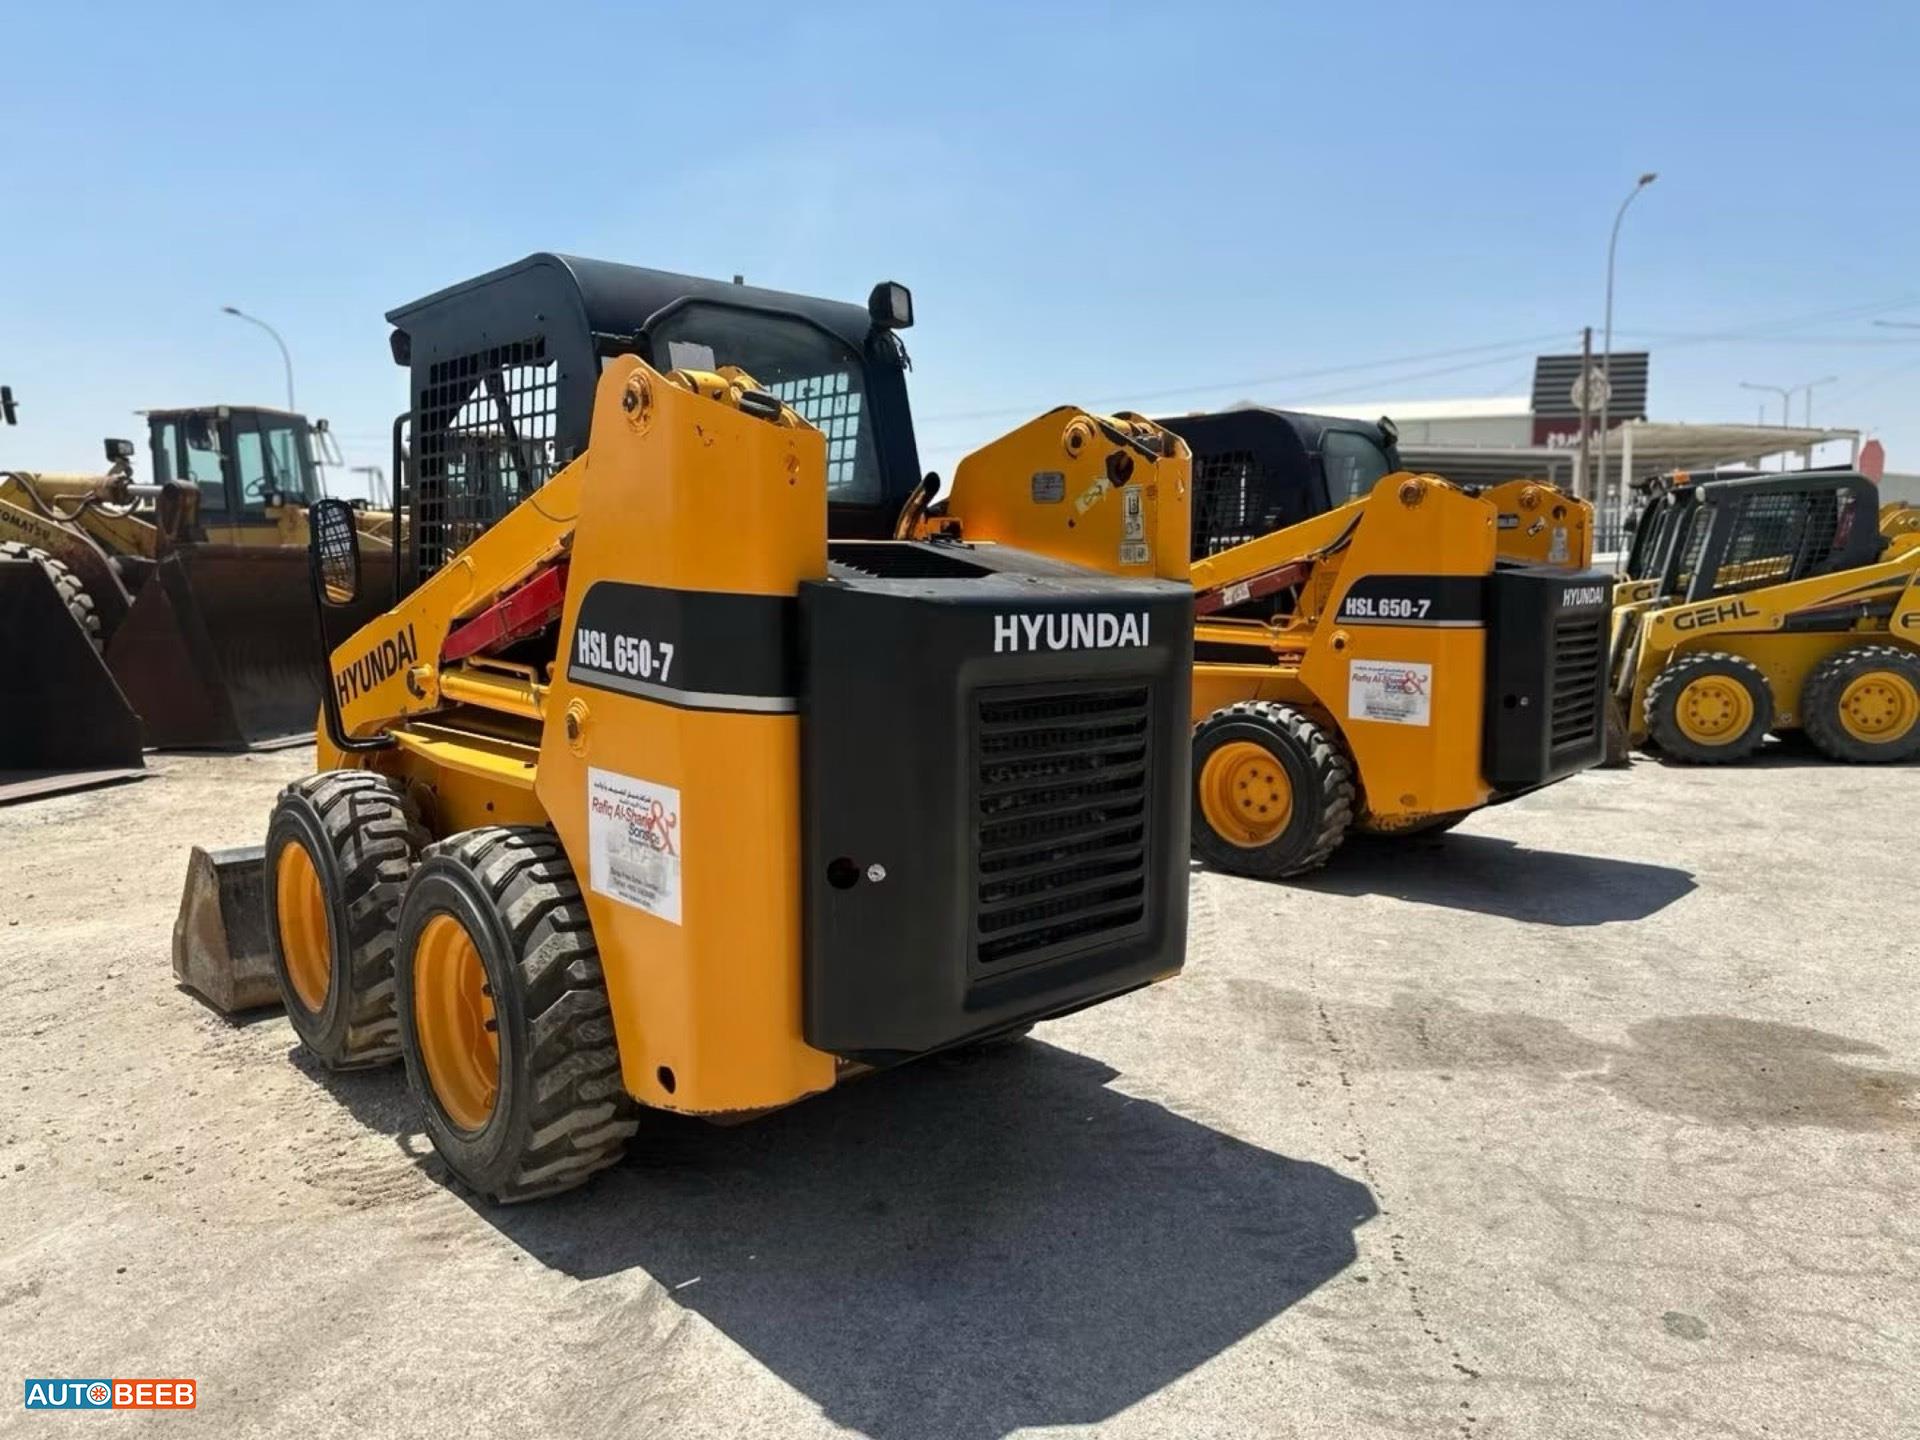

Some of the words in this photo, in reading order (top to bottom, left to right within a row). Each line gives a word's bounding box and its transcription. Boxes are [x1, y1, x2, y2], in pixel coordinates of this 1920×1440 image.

[0, 509, 51, 541] OMATSU
[1346, 597, 1377, 616] HSL
[1378, 598, 1431, 619] 650-7
[1562, 586, 1604, 607] HYUNDAI
[1673, 601, 1760, 630] GEHL
[994, 612, 1150, 652] HYUNDAI
[336, 622, 418, 708] HYUNDAI
[578, 628, 612, 670] HSL
[614, 634, 674, 682] 650-7
[592, 796, 613, 821] Rafiq
